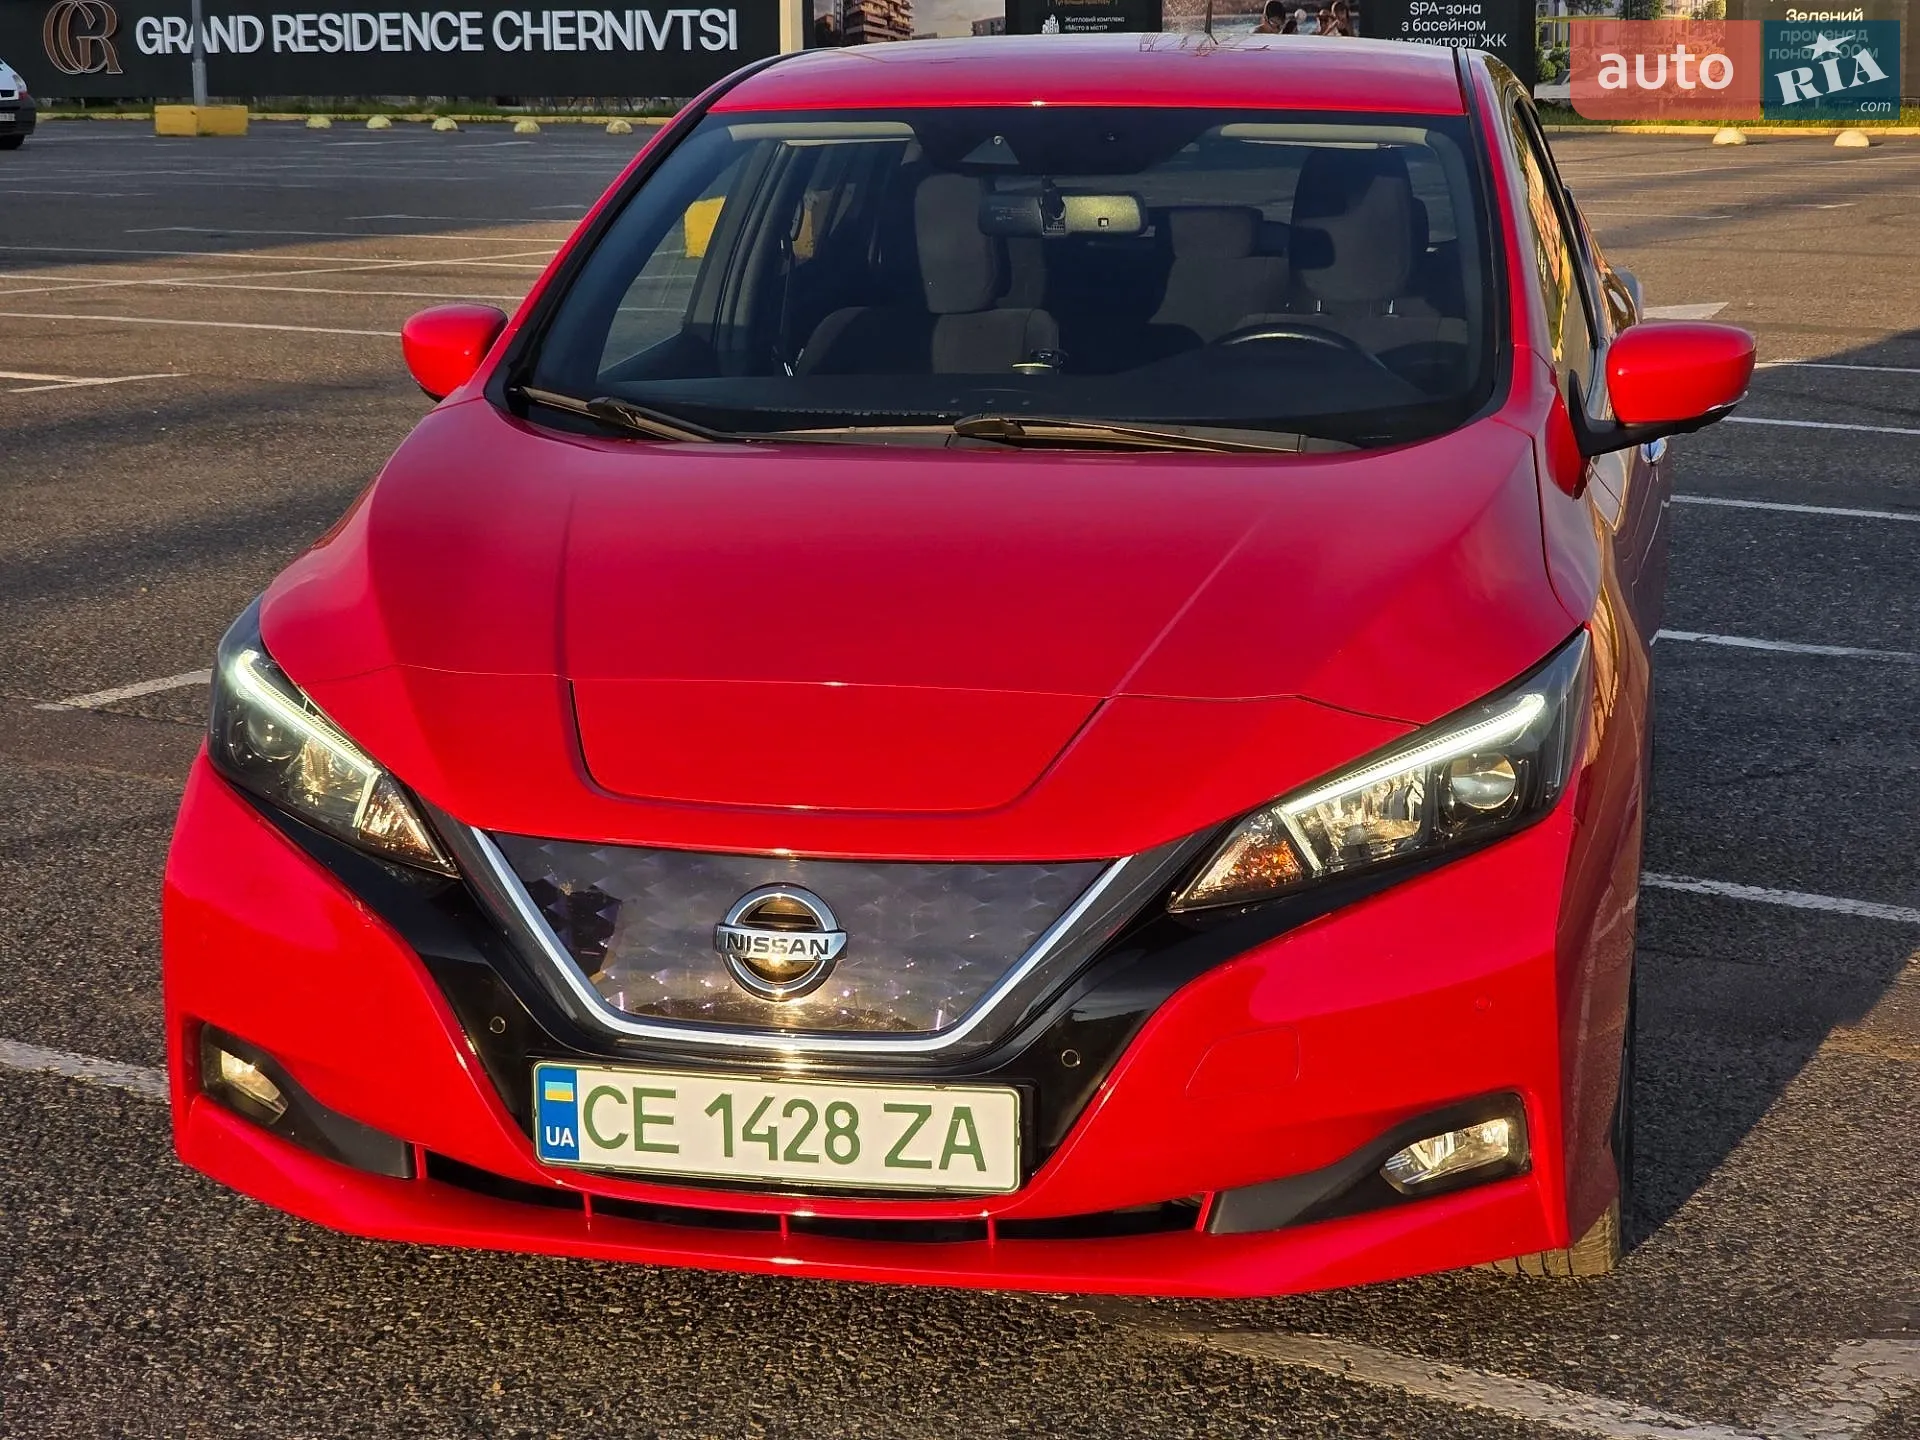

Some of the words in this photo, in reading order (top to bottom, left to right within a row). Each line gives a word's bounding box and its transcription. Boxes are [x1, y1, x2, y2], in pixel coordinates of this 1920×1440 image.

[1409, 2, 1481, 15] SPA-зона
[1786, 8, 1864, 23] Зелений
[135, 15, 265, 55] GRAND
[271, 11, 485, 53] RESIDENCE
[492, 8, 738, 51] CHERNIVTSI
[1412, 18, 1486, 31] басейном
[1480, 33, 1507, 47] ЖК
[1768, 47, 1824, 60] пона
[727, 932, 829, 956] NISSAN
[583, 1085, 680, 1154] CE
[704, 1092, 861, 1166] 1428
[883, 1102, 987, 1172] ZA
[545, 1126, 575, 1148] UA
